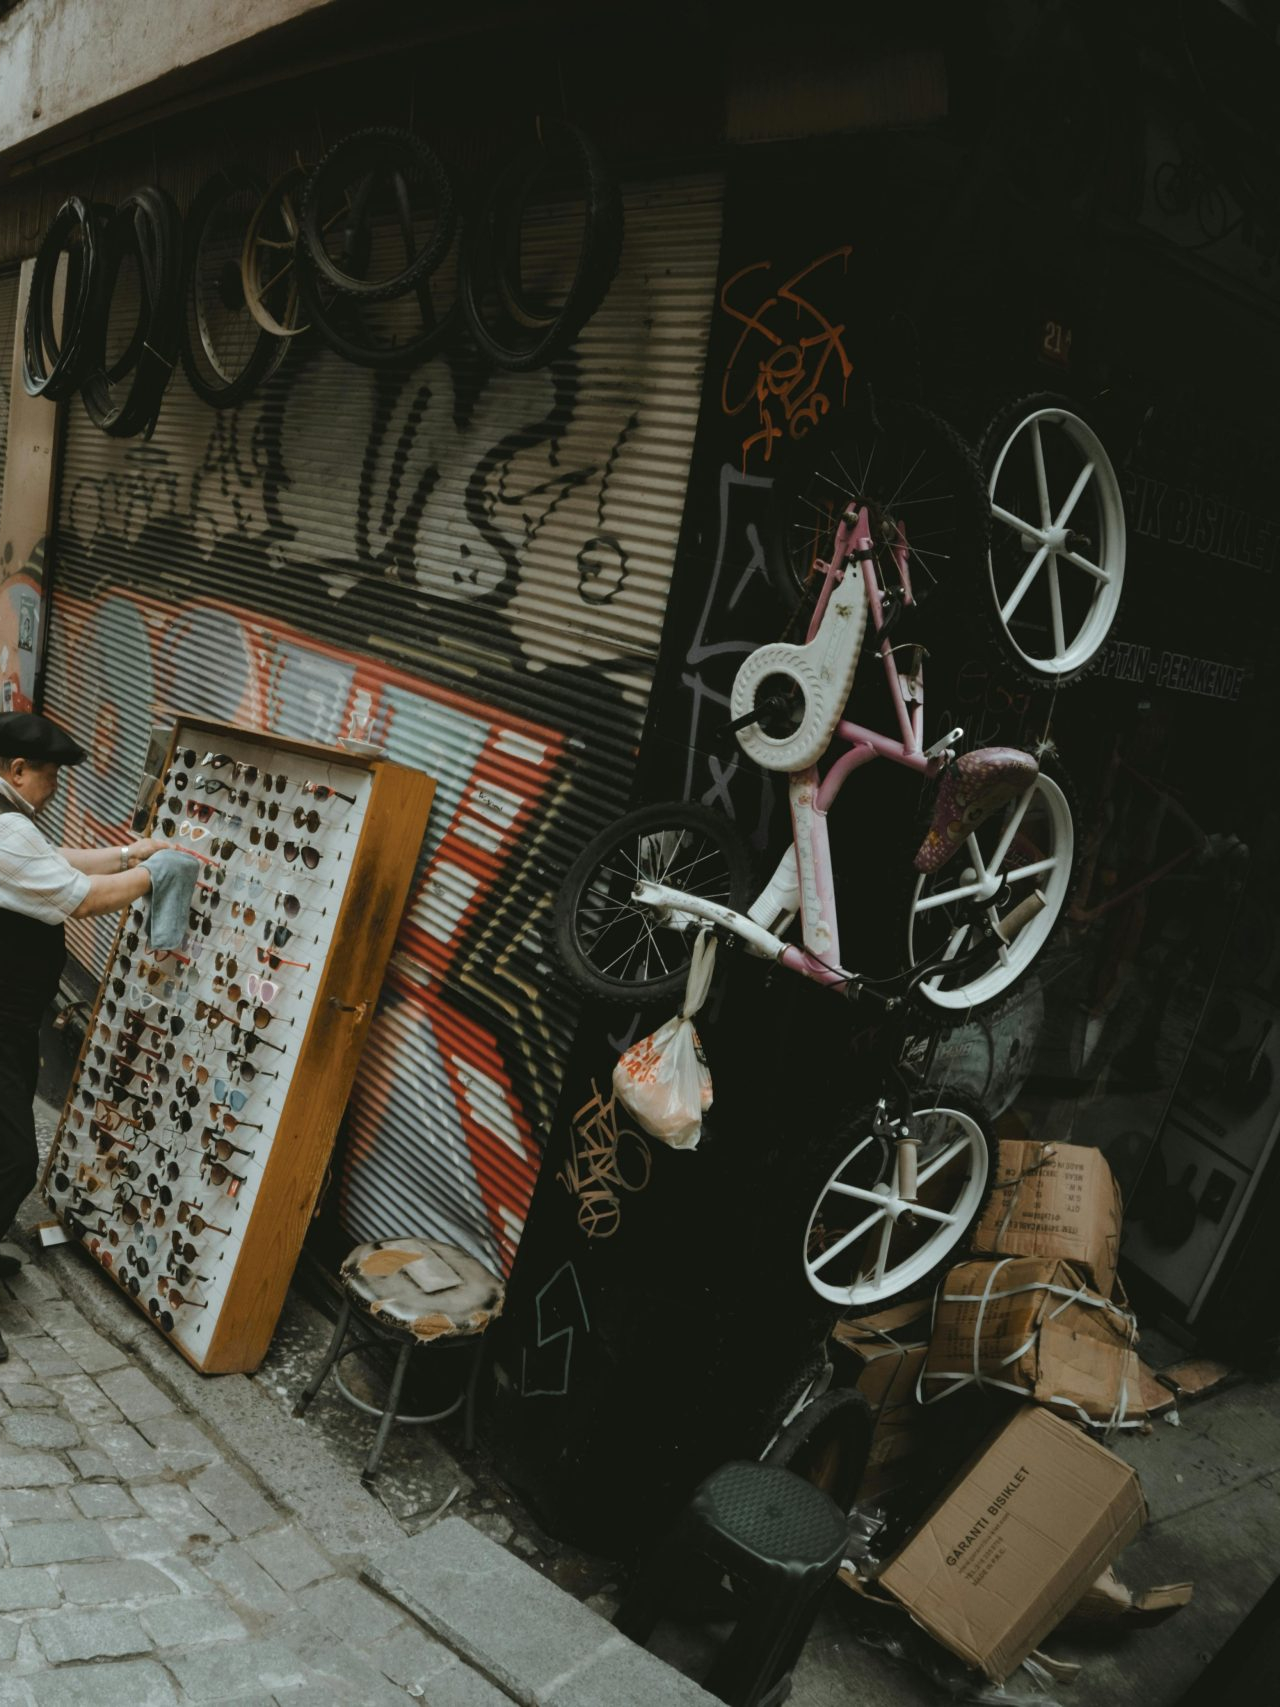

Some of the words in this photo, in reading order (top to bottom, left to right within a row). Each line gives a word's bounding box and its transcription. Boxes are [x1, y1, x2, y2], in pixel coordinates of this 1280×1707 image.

[1156, 651, 1246, 702] PERAKENDE
[946, 1516, 990, 1567] GARANTI
[987, 1465, 1030, 1516] BISIKLET
